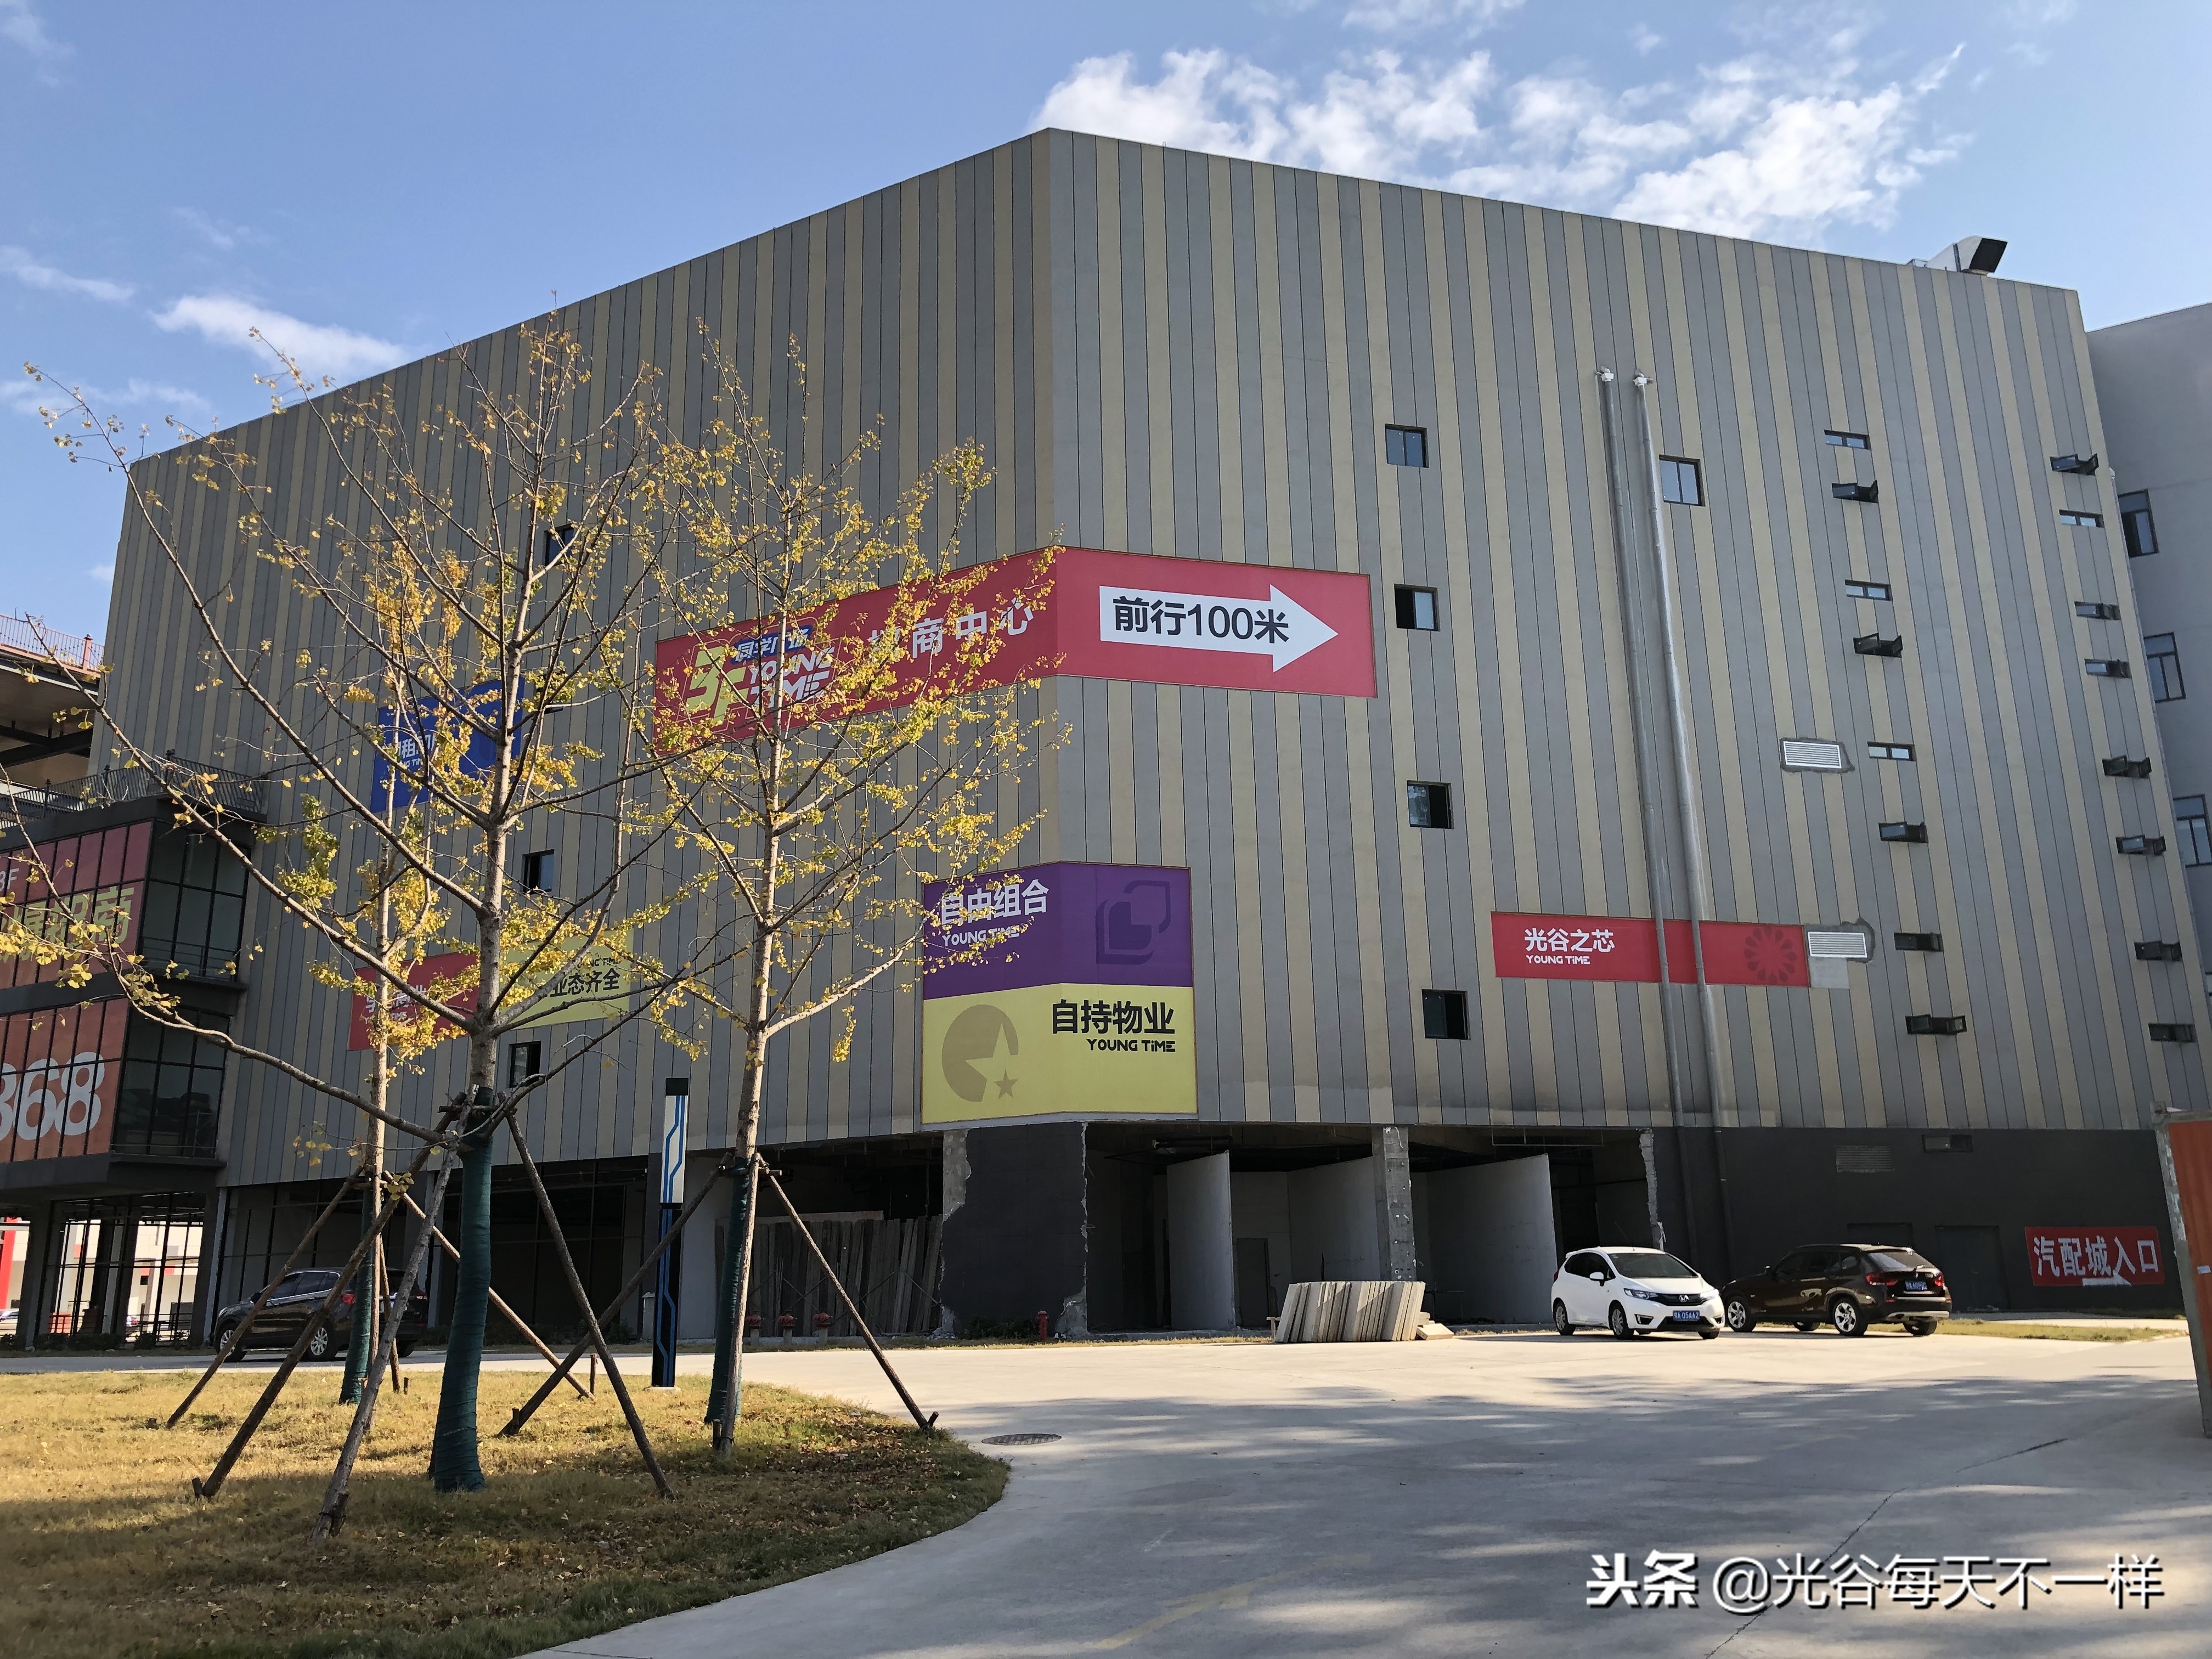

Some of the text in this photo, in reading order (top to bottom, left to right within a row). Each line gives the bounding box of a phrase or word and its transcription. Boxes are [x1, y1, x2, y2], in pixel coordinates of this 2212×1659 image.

[1113, 596, 1289, 644] 前行100米
[941, 879, 1049, 925] 自由组合
[942, 930, 986, 946] YOUNG
[1525, 927, 1615, 952] 光谷之芯
[1526, 955, 1564, 964] YOUNG
[550, 967, 620, 997] 业态齐全
[1052, 999, 1175, 1034] 自持物业
[1086, 1039, 1138, 1052] YOUNG
[2033, 1235, 2159, 1277] 汽配城入口
